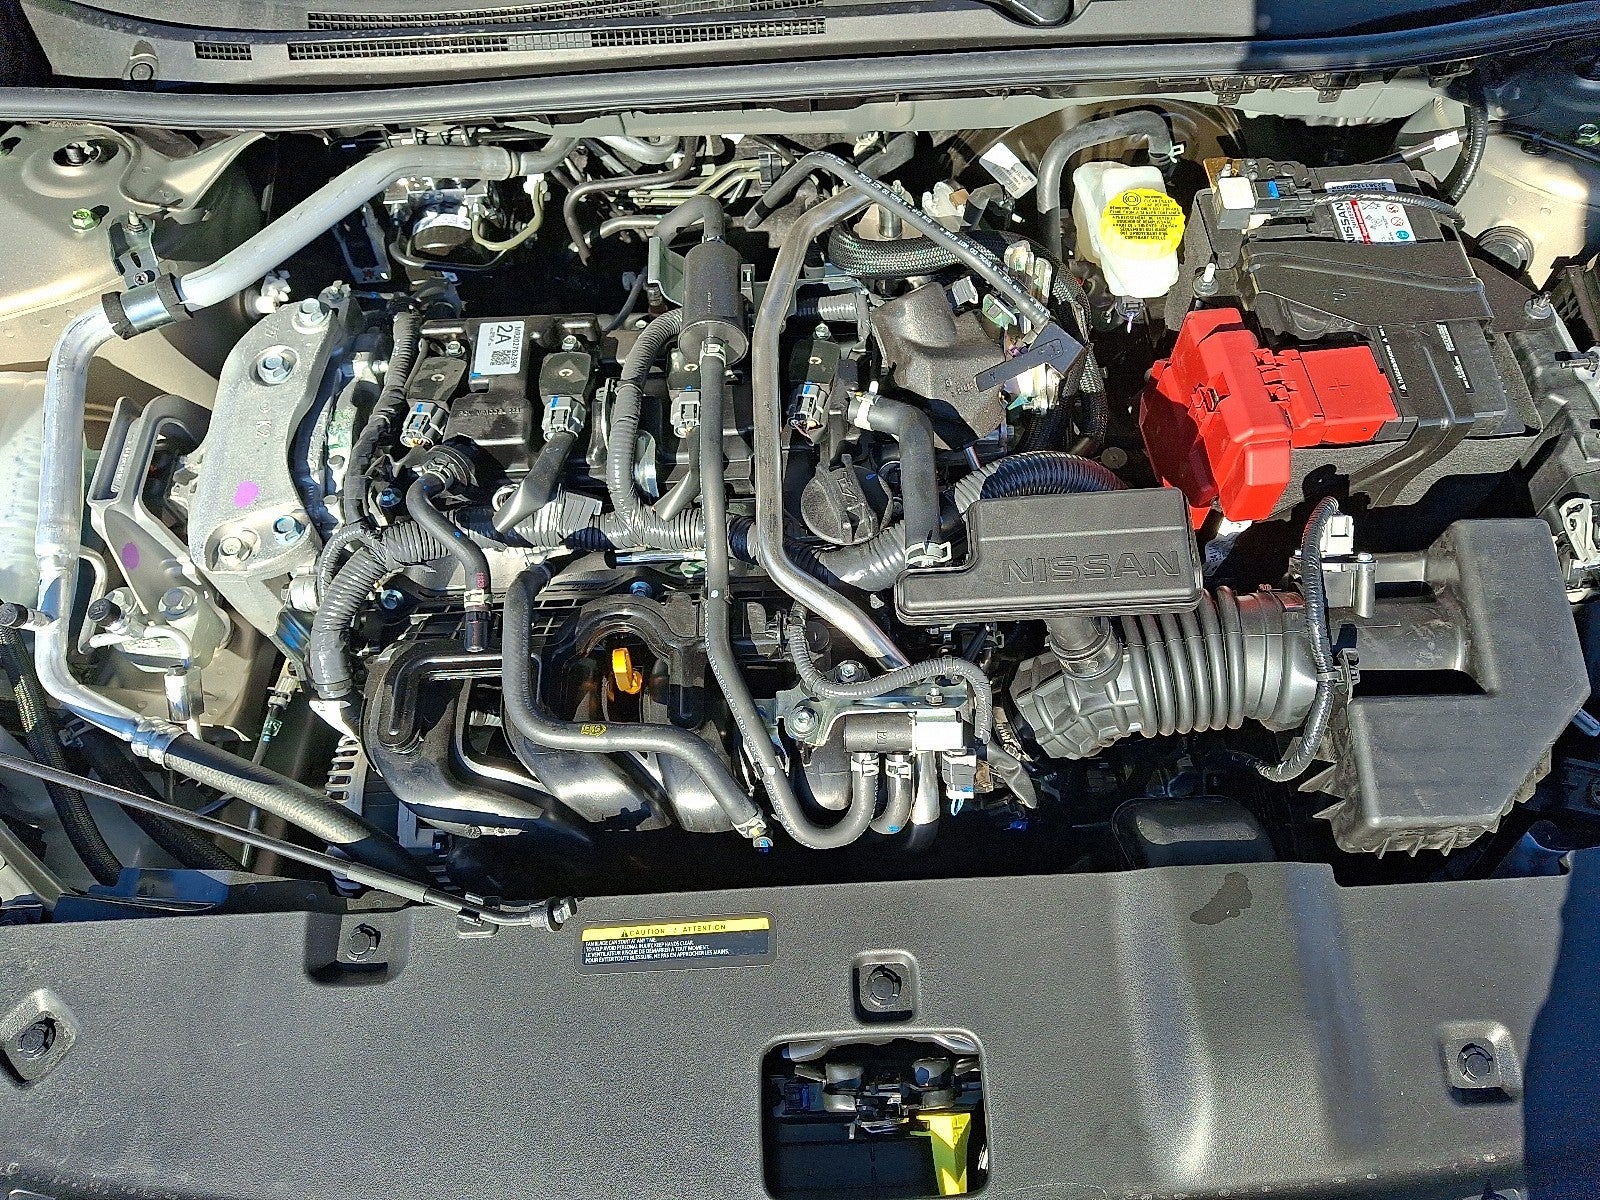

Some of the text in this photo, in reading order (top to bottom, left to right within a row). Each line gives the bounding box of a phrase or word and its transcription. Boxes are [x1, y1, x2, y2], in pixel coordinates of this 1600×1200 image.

[495, 324, 514, 345] 2A
[1002, 551, 1181, 585] NISSAN
[629, 929, 665, 937] CAUTION
[683, 924, 726, 933] ATTENTION
